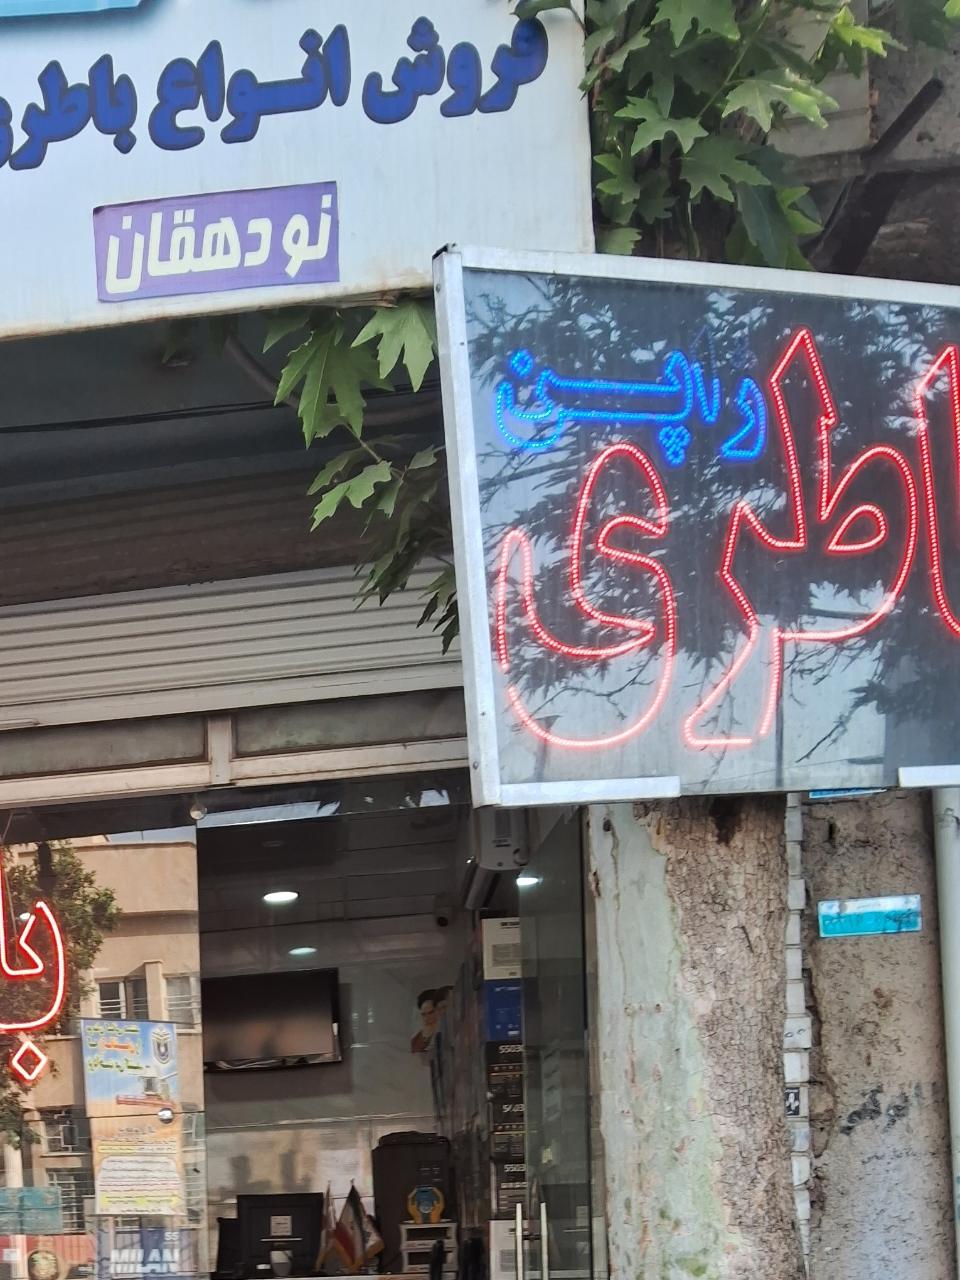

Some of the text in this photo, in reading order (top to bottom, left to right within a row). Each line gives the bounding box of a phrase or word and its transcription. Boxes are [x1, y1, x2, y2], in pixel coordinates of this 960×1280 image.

[147, 22, 351, 152] انواع
[361, 14, 550, 126] فروش
[495, 327, 960, 750] اطری
